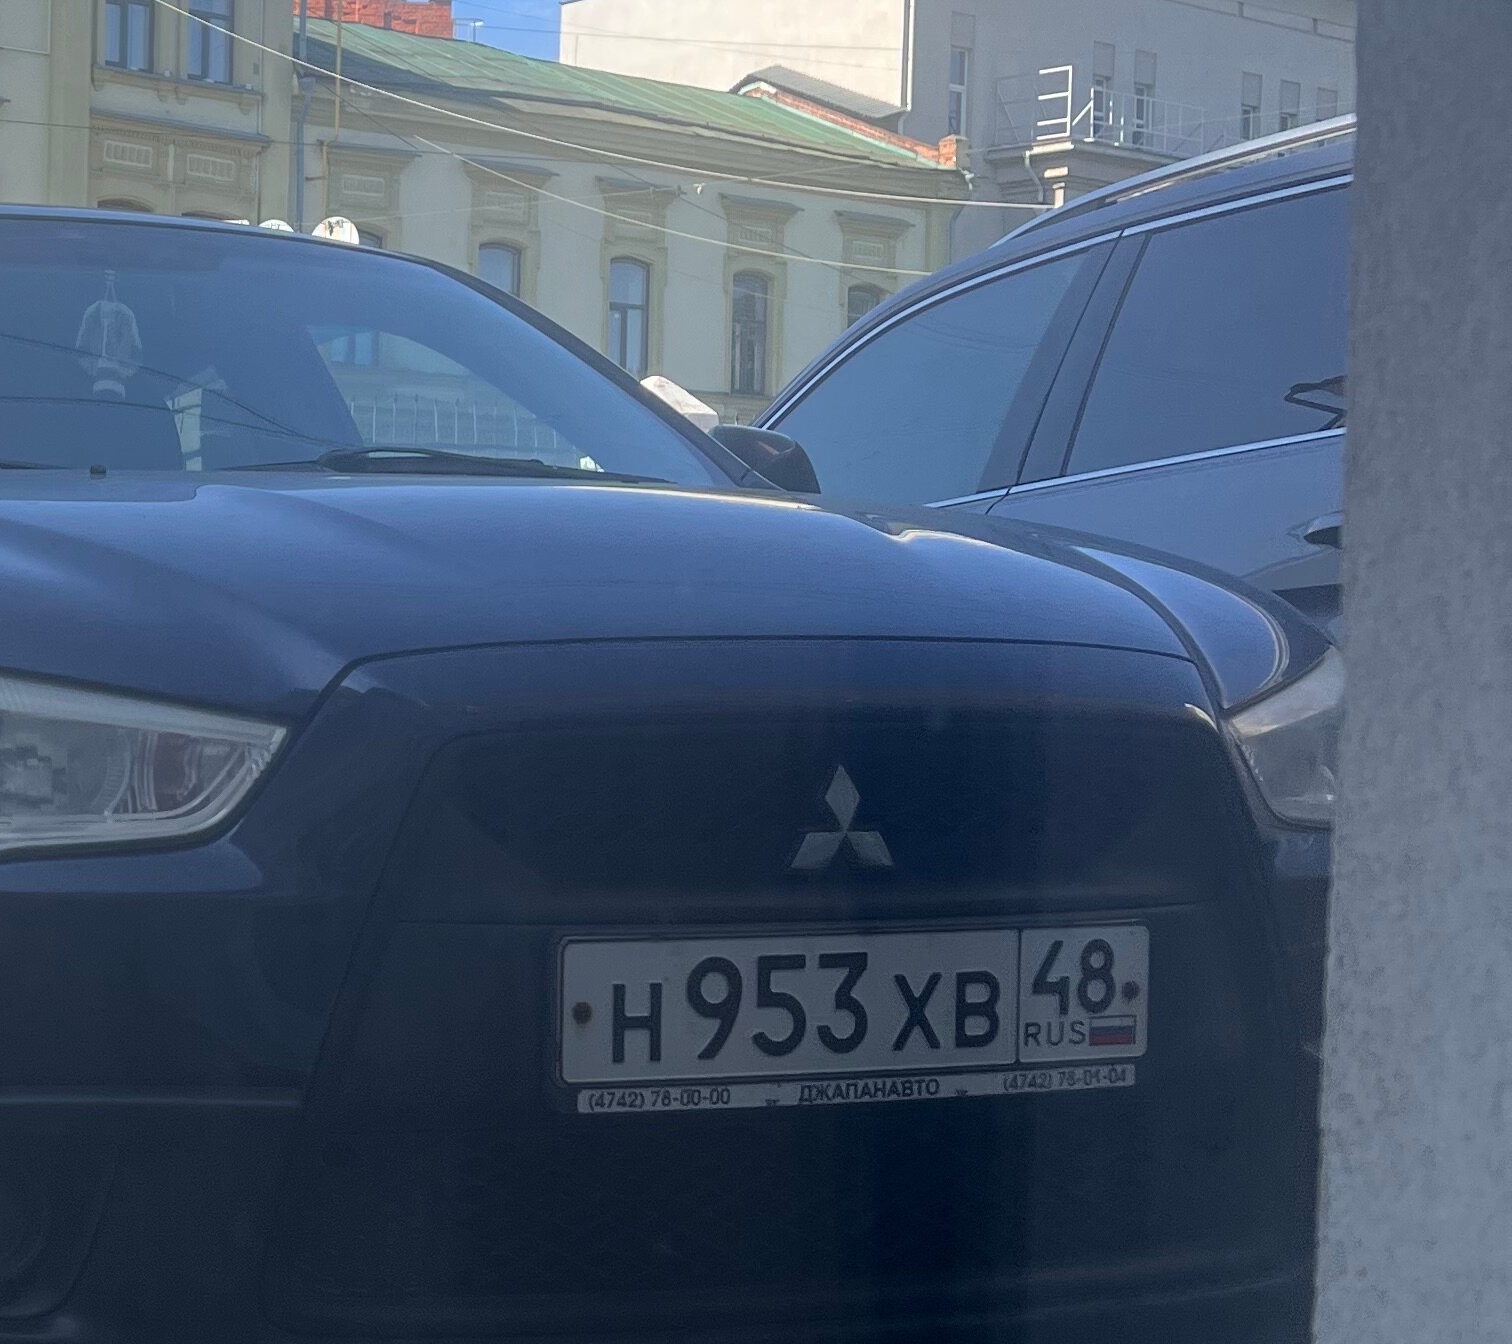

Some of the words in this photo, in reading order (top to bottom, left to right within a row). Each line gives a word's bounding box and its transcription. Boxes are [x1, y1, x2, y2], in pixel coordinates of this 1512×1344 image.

[1031, 938, 1116, 1016] 48
[1023, 1022, 1087, 1048] RUS
[798, 1078, 939, 1104] ДЖАПАНАВТО
[1002, 1071, 1053, 1092] (4742)
[588, 1089, 645, 1111] (4742)
